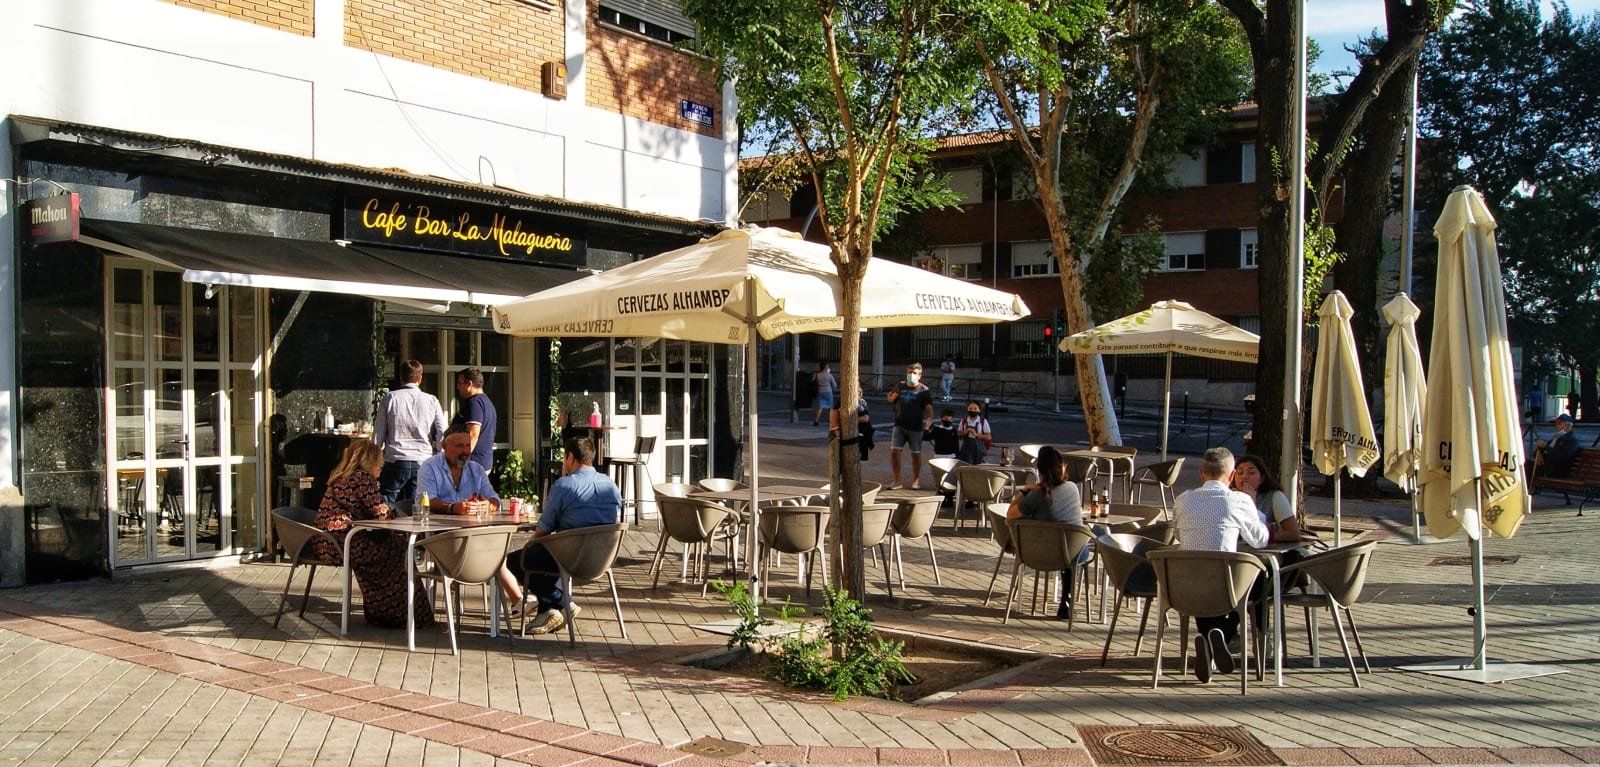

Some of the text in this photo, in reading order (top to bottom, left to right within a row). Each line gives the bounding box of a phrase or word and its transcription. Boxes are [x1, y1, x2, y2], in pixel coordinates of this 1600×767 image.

[31, 205, 67, 224] Mahou
[415, 205, 452, 236] Bar
[453, 212, 481, 241] La
[480, 212, 573, 256] Malagueña
[617, 292, 669, 314] CERVEZAS
[915, 293, 966, 311] CERVEZAS
[1113, 343, 1139, 351] parasol
